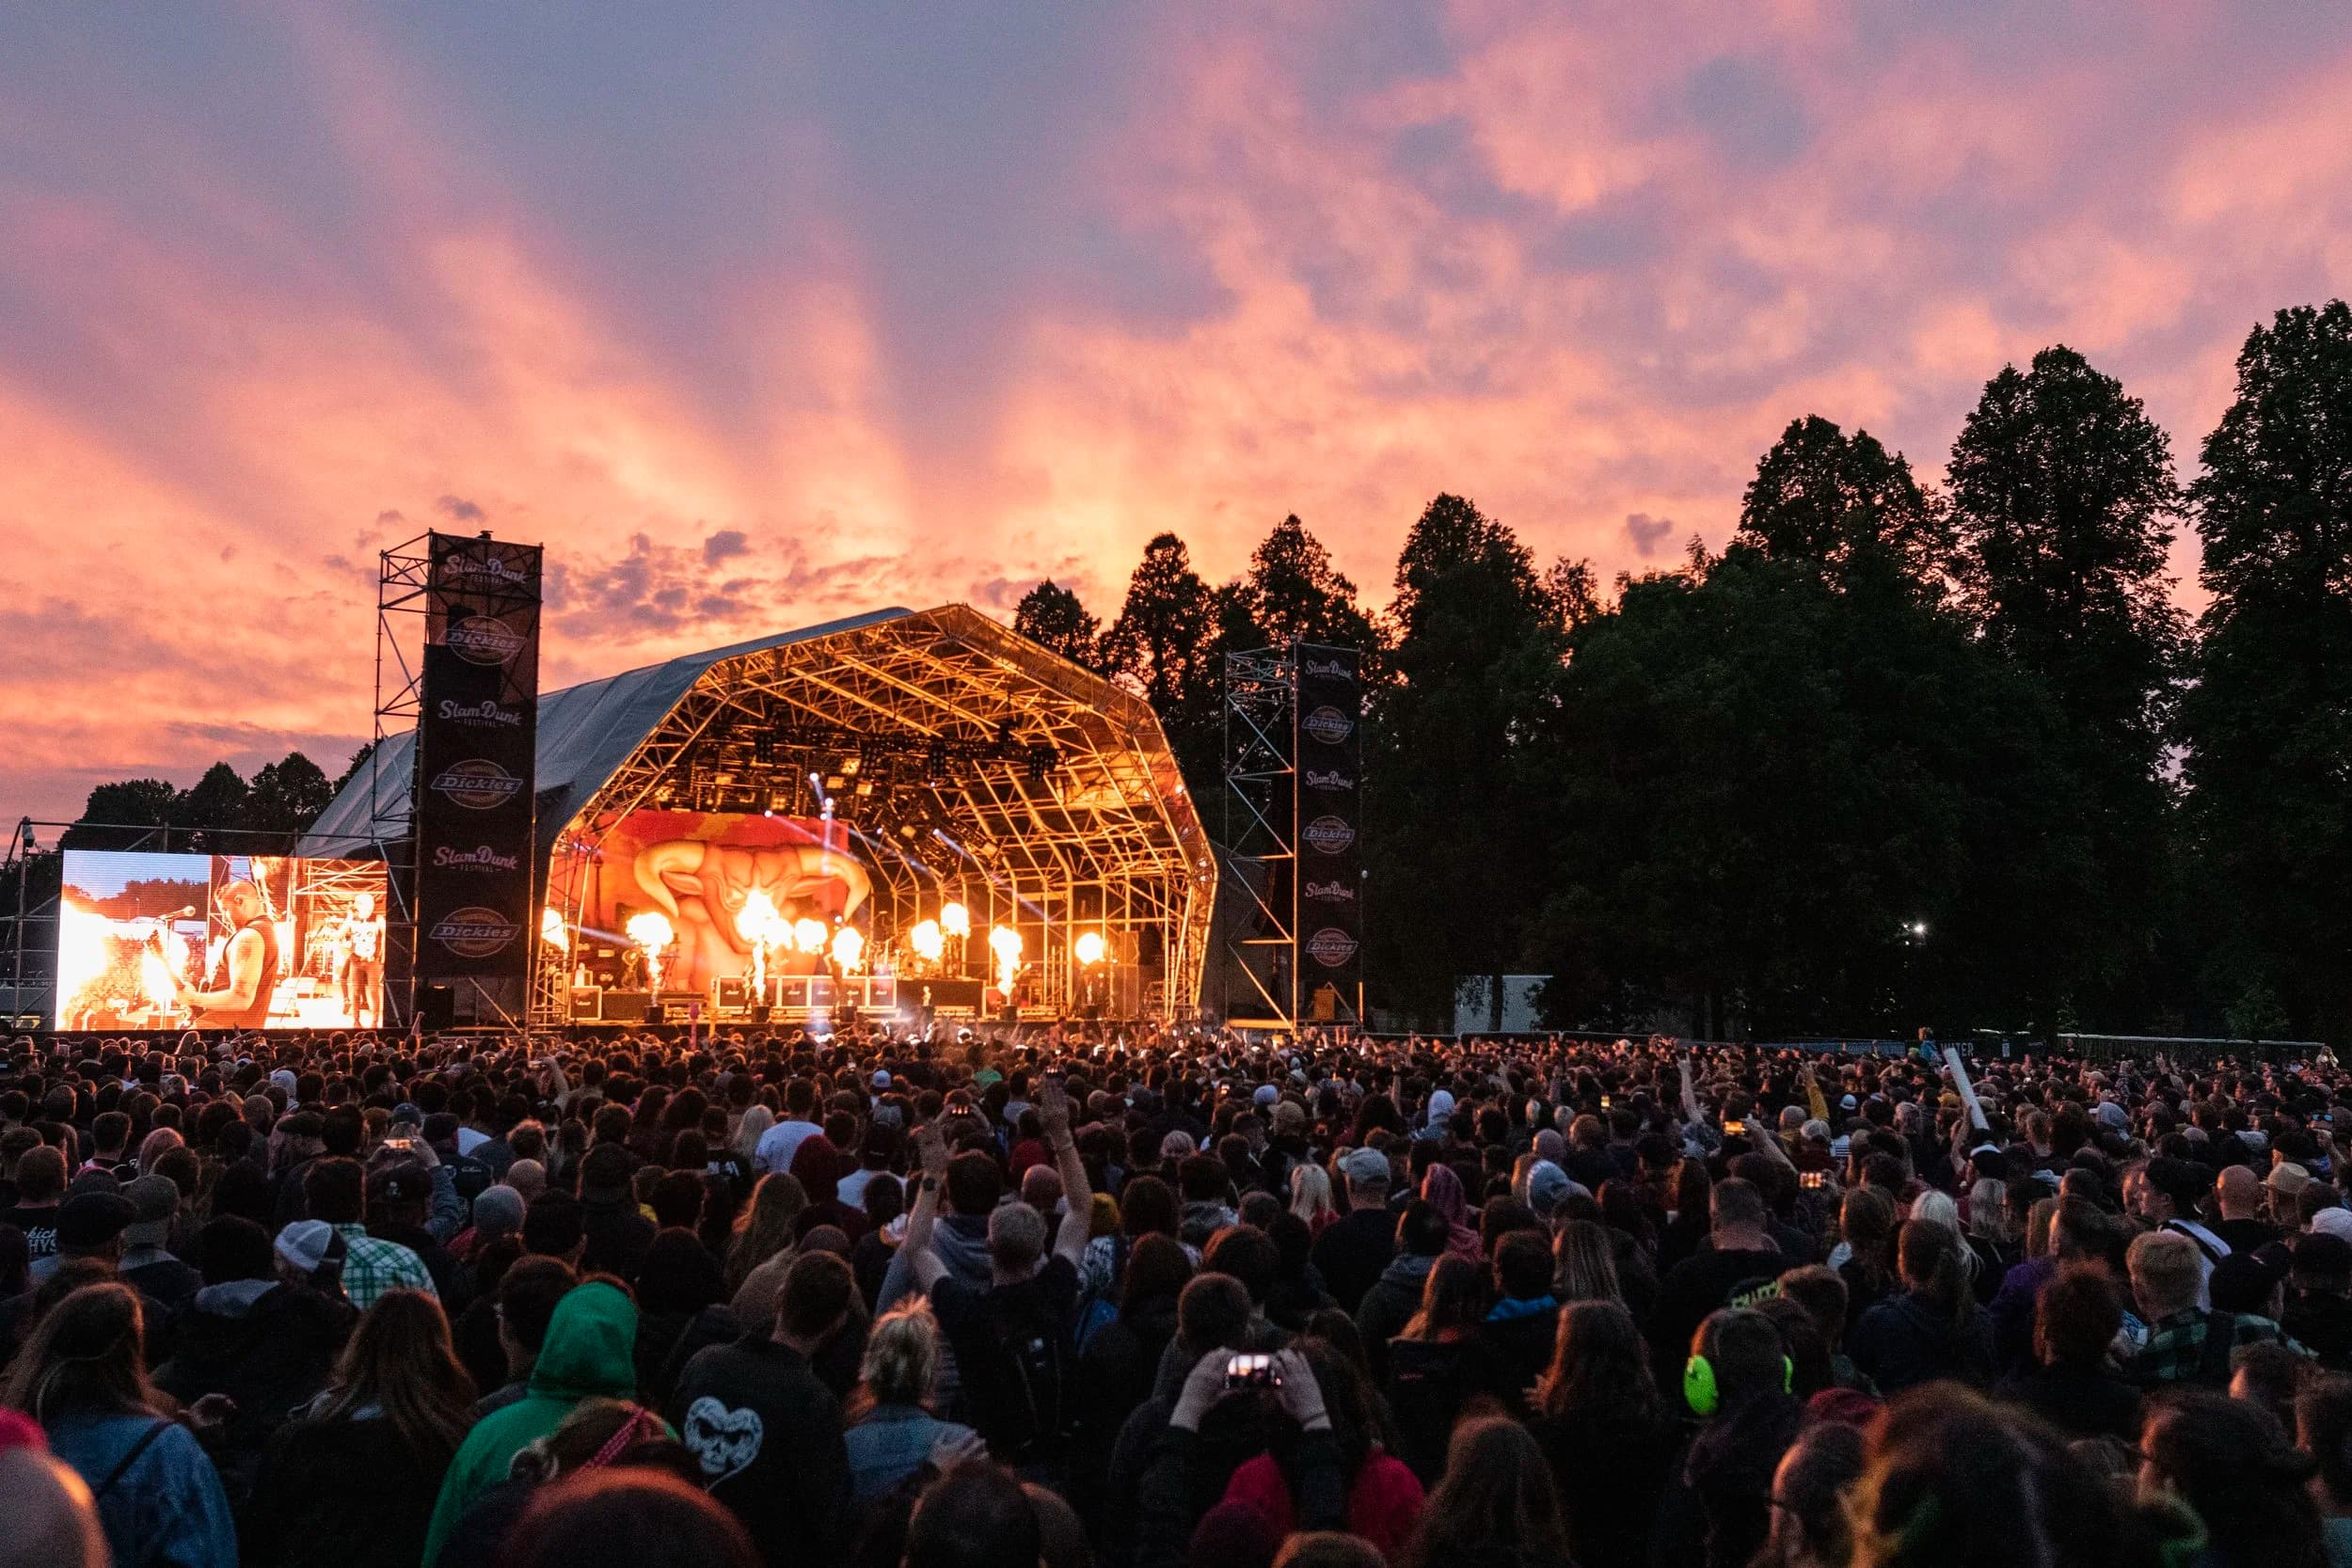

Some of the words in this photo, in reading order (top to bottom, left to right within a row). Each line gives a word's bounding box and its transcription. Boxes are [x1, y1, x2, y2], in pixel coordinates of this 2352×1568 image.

[447, 632, 518, 648] Dickies
[1308, 719, 1348, 730] Dickies
[440, 777, 515, 791] Dickies
[1309, 829, 1350, 839] Dickies
[437, 926, 512, 937] Dickies
[1311, 942, 1353, 952] Dickies
